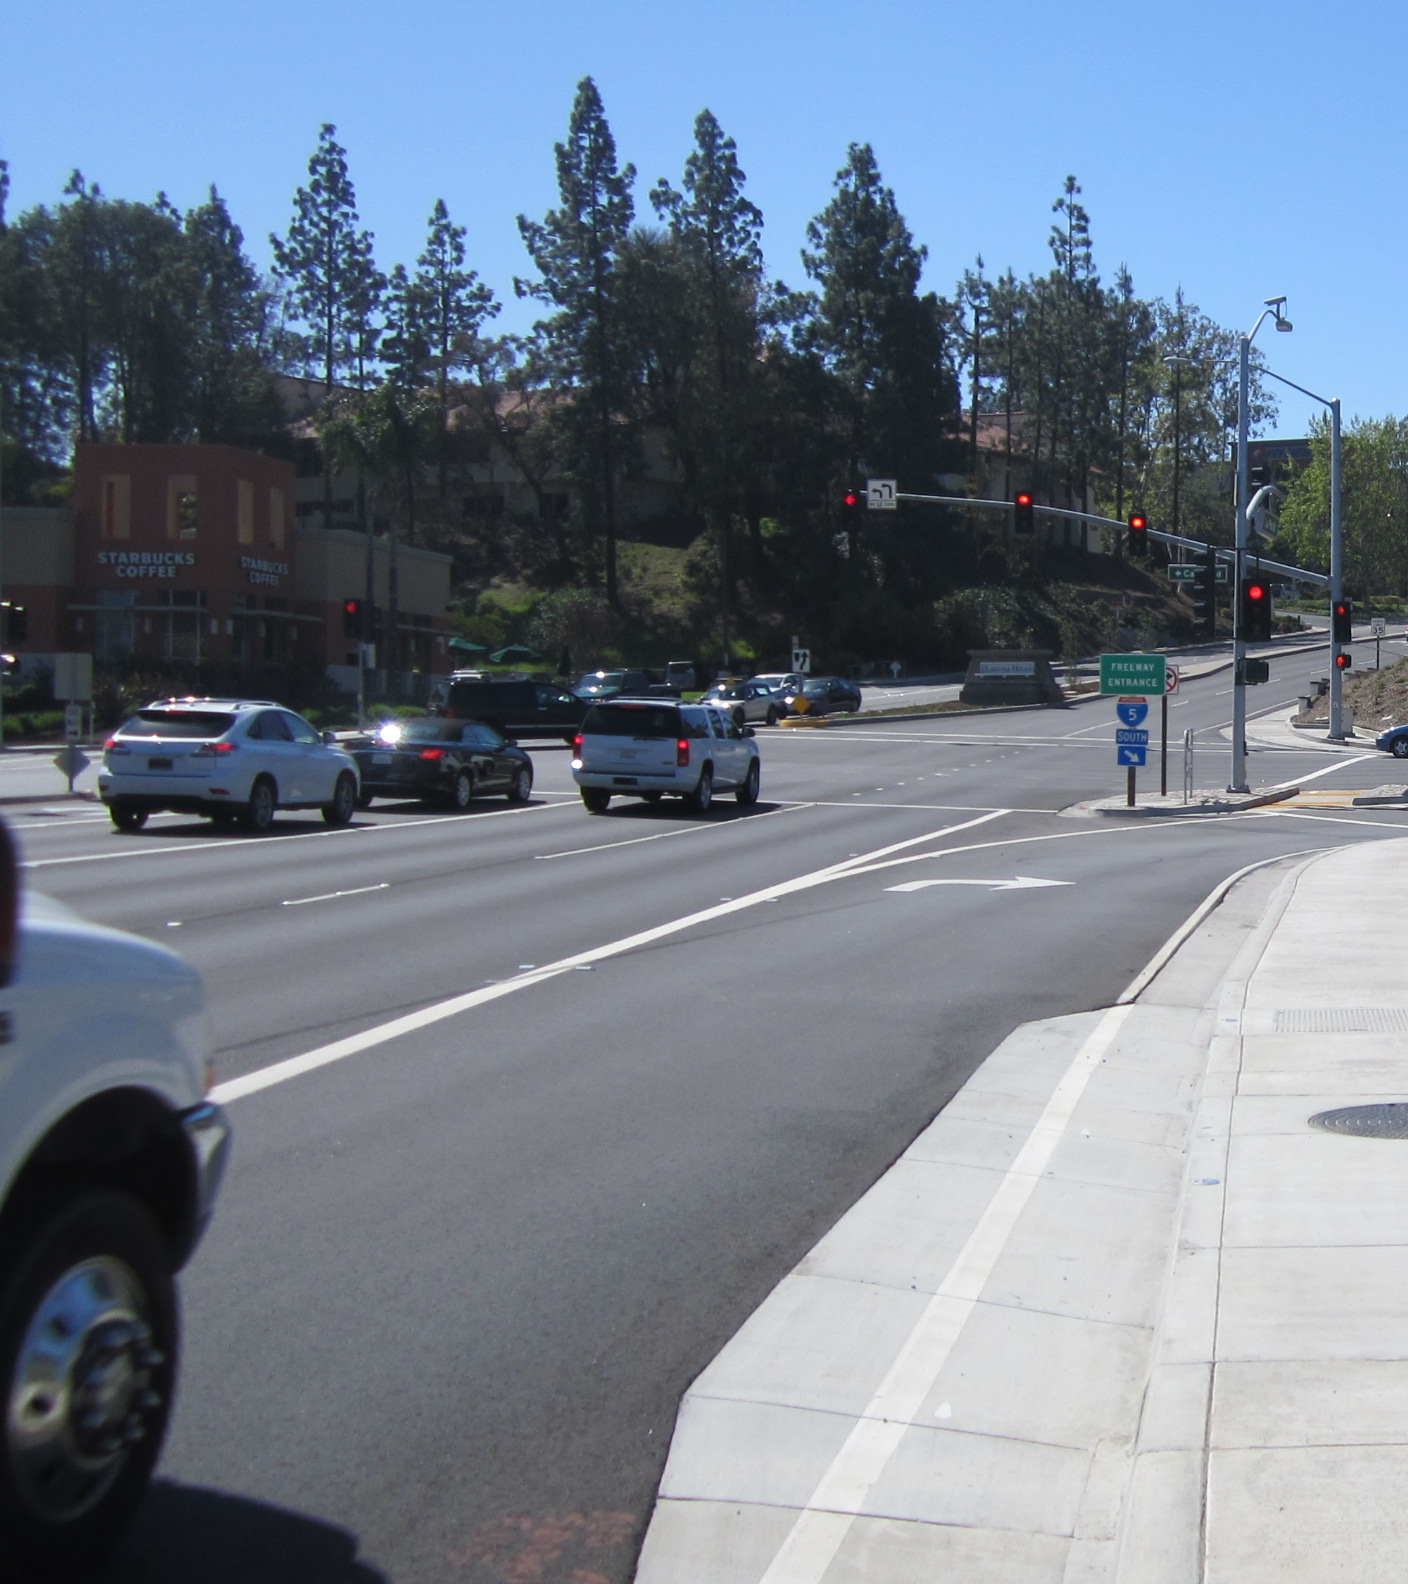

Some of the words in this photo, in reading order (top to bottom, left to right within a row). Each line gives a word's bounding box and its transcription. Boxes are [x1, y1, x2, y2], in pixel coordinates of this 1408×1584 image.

[97, 552, 195, 565] STARBUCKS
[116, 565, 177, 578] COFFEE
[240, 556, 289, 575] STARBUCKS
[249, 571, 280, 587] COFFEE
[1372, 626, 1384, 635] 35
[1111, 663, 1156, 672] FREEWAY
[1108, 678, 1158, 687] ENTRANCE
[1128, 708, 1137, 721] 5
[1117, 731, 1147, 742] SOUTH
